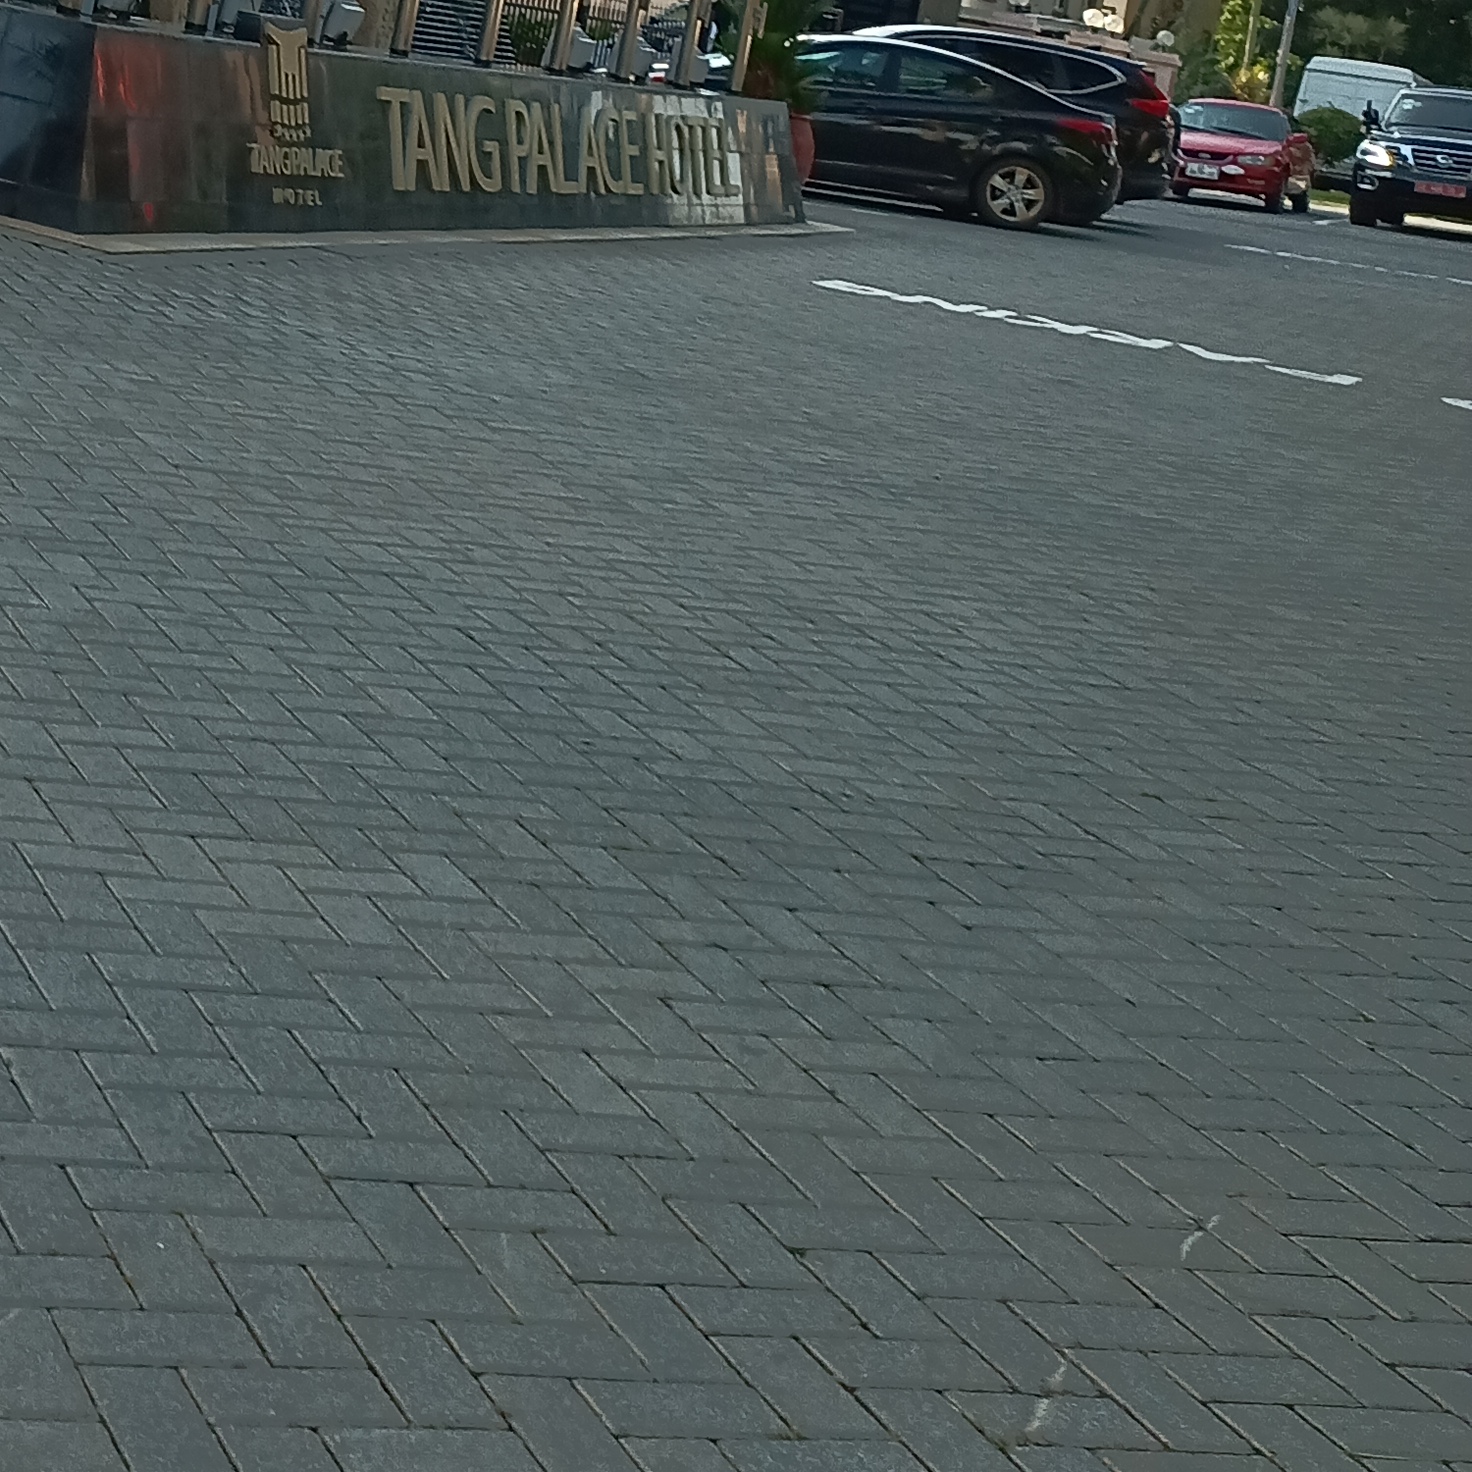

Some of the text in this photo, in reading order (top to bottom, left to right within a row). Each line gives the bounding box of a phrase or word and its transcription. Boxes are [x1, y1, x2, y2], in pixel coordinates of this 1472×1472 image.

[376, 86, 740, 197] TANG PALACE HOTEL
